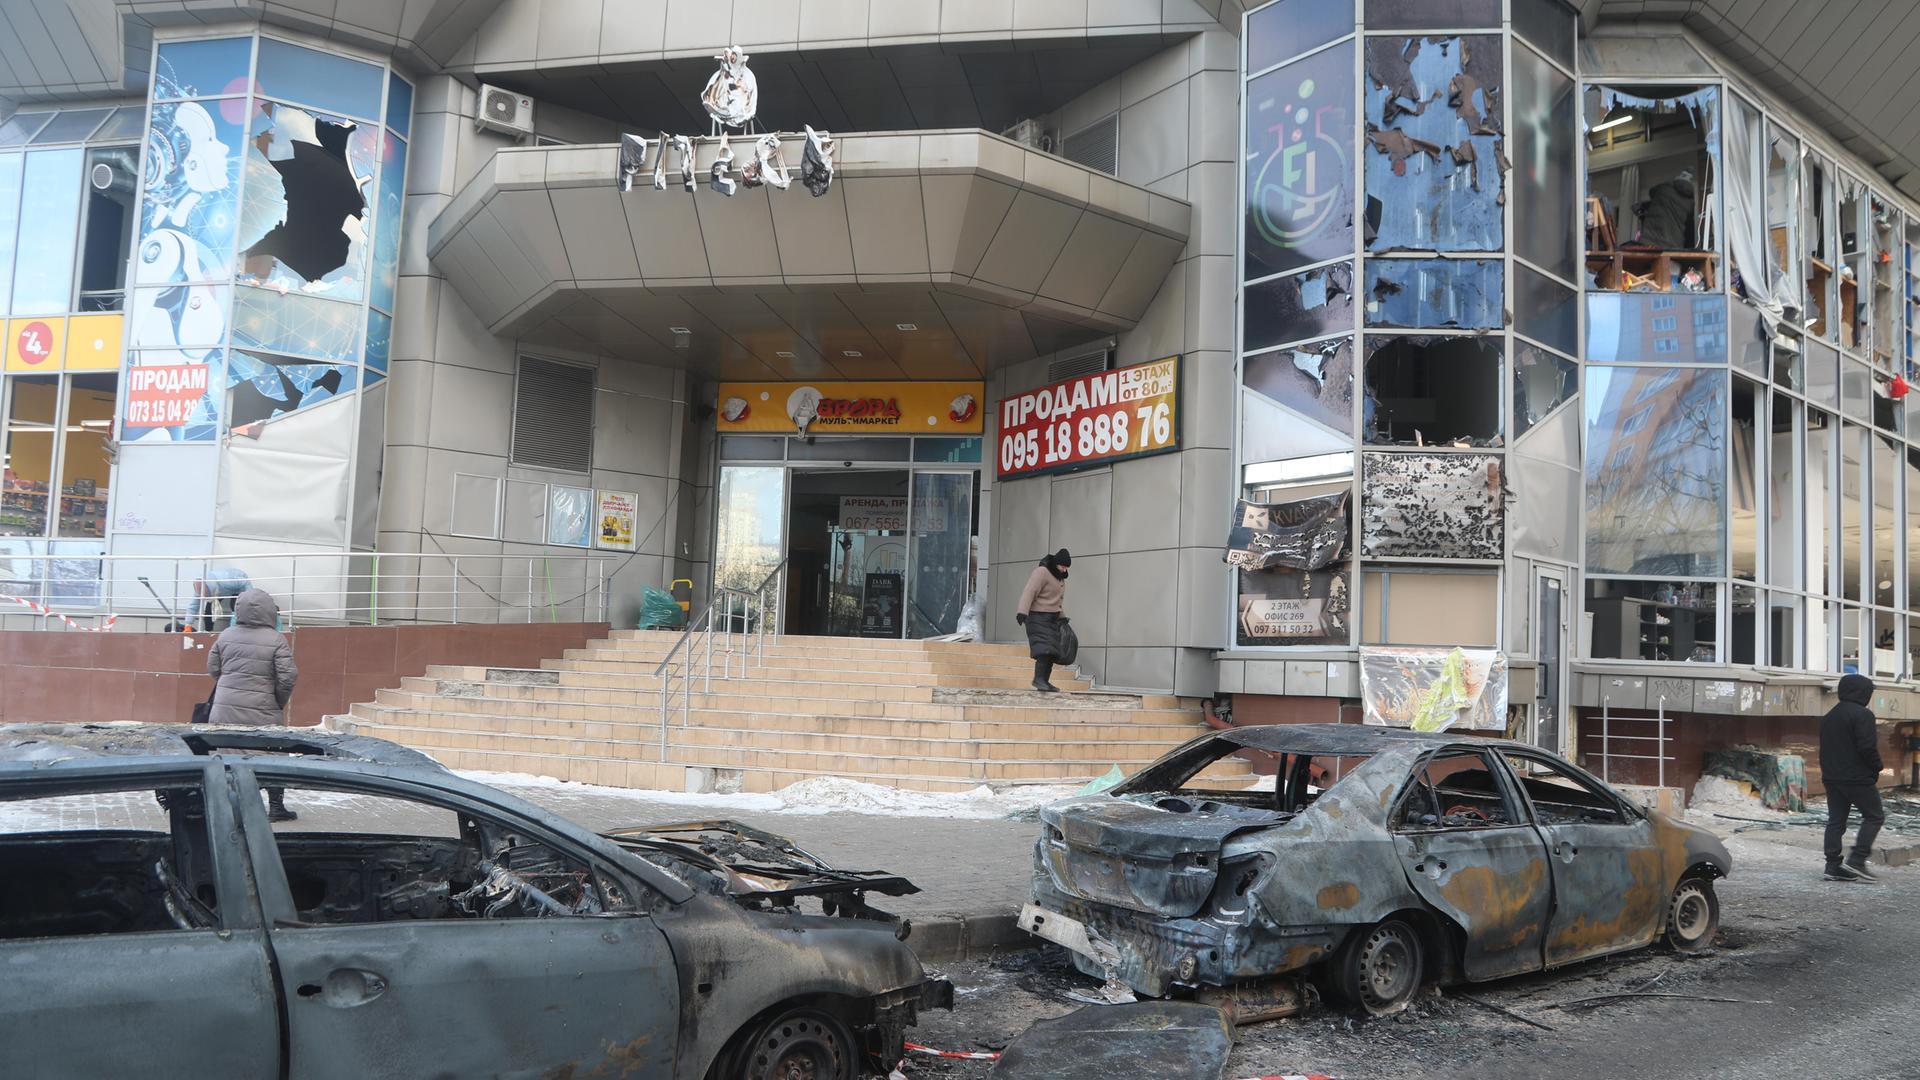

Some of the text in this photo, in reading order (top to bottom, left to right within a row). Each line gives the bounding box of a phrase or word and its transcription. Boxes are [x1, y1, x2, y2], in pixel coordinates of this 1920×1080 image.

[132, 368, 206, 393] ПРОДАМ
[1121, 364, 1170, 385] 1 ЭТАЖ
[1142, 380, 1159, 396] 80
[1004, 373, 1117, 429] ПРОДАМ
[130, 401, 149, 422] 073
[152, 400, 165, 422] 15
[168, 400, 181, 421] 04
[819, 417, 899, 425] МУЛЬТИМАРКЕТ
[1002, 402, 1170, 472] 095 18 888 76
[844, 499, 888, 508] АРЕНДА,
[1278, 602, 1300, 610] ЭТАЖ
[1254, 625, 1313, 634] 097 311 50 32
